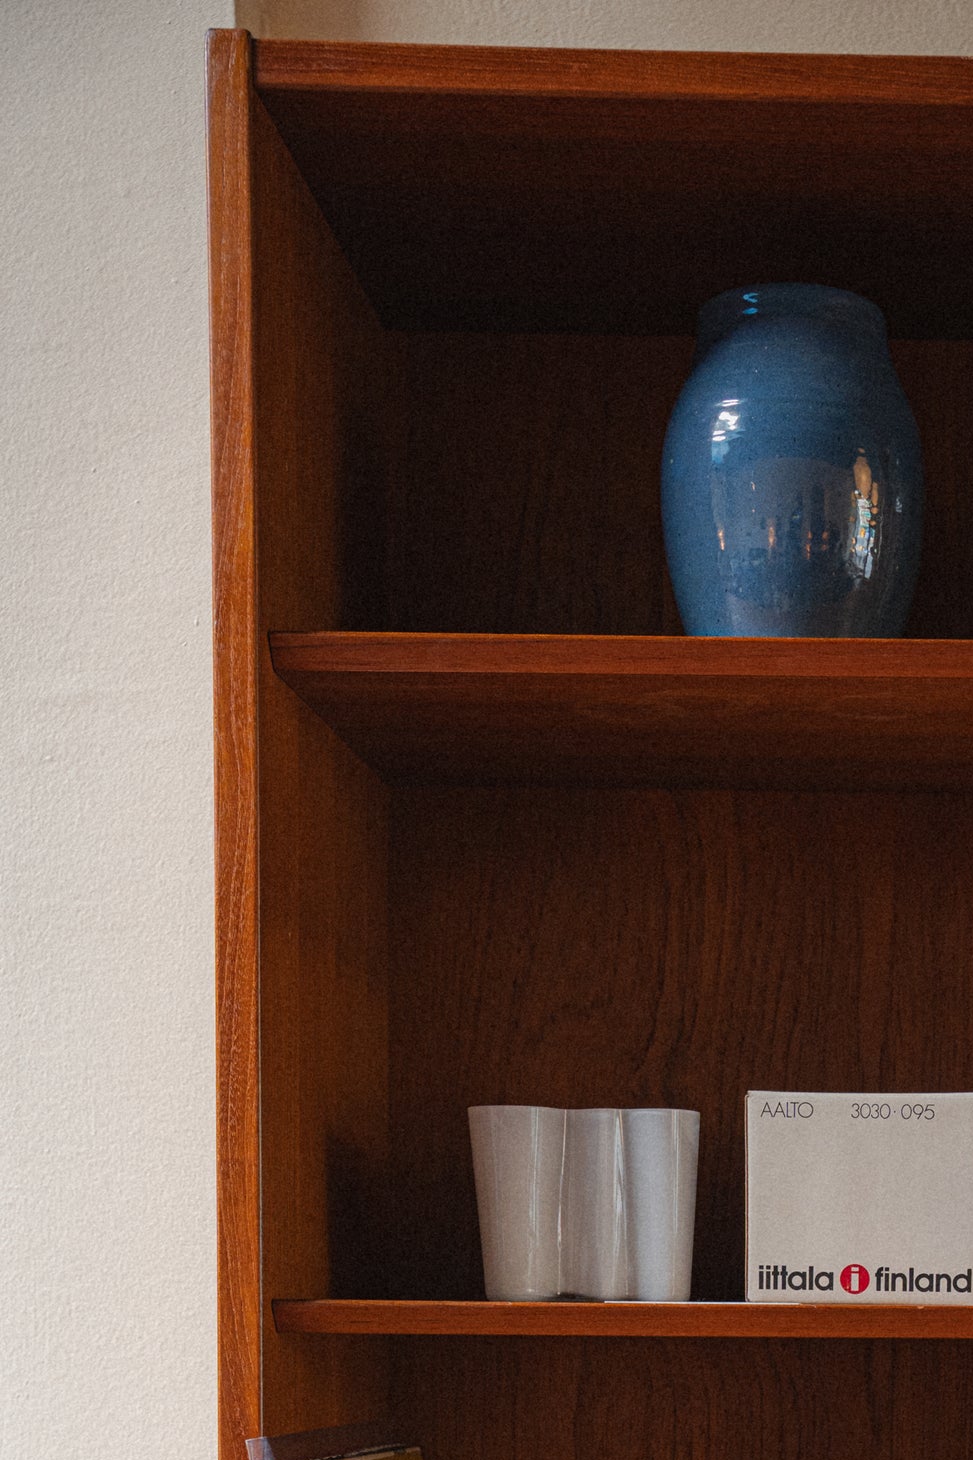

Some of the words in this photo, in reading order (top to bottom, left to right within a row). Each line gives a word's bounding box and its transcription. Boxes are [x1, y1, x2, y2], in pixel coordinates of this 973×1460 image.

[760, 1101, 814, 1119] AALTO
[757, 1264, 834, 1292] iittala
[875, 1267, 972, 1293] finland
